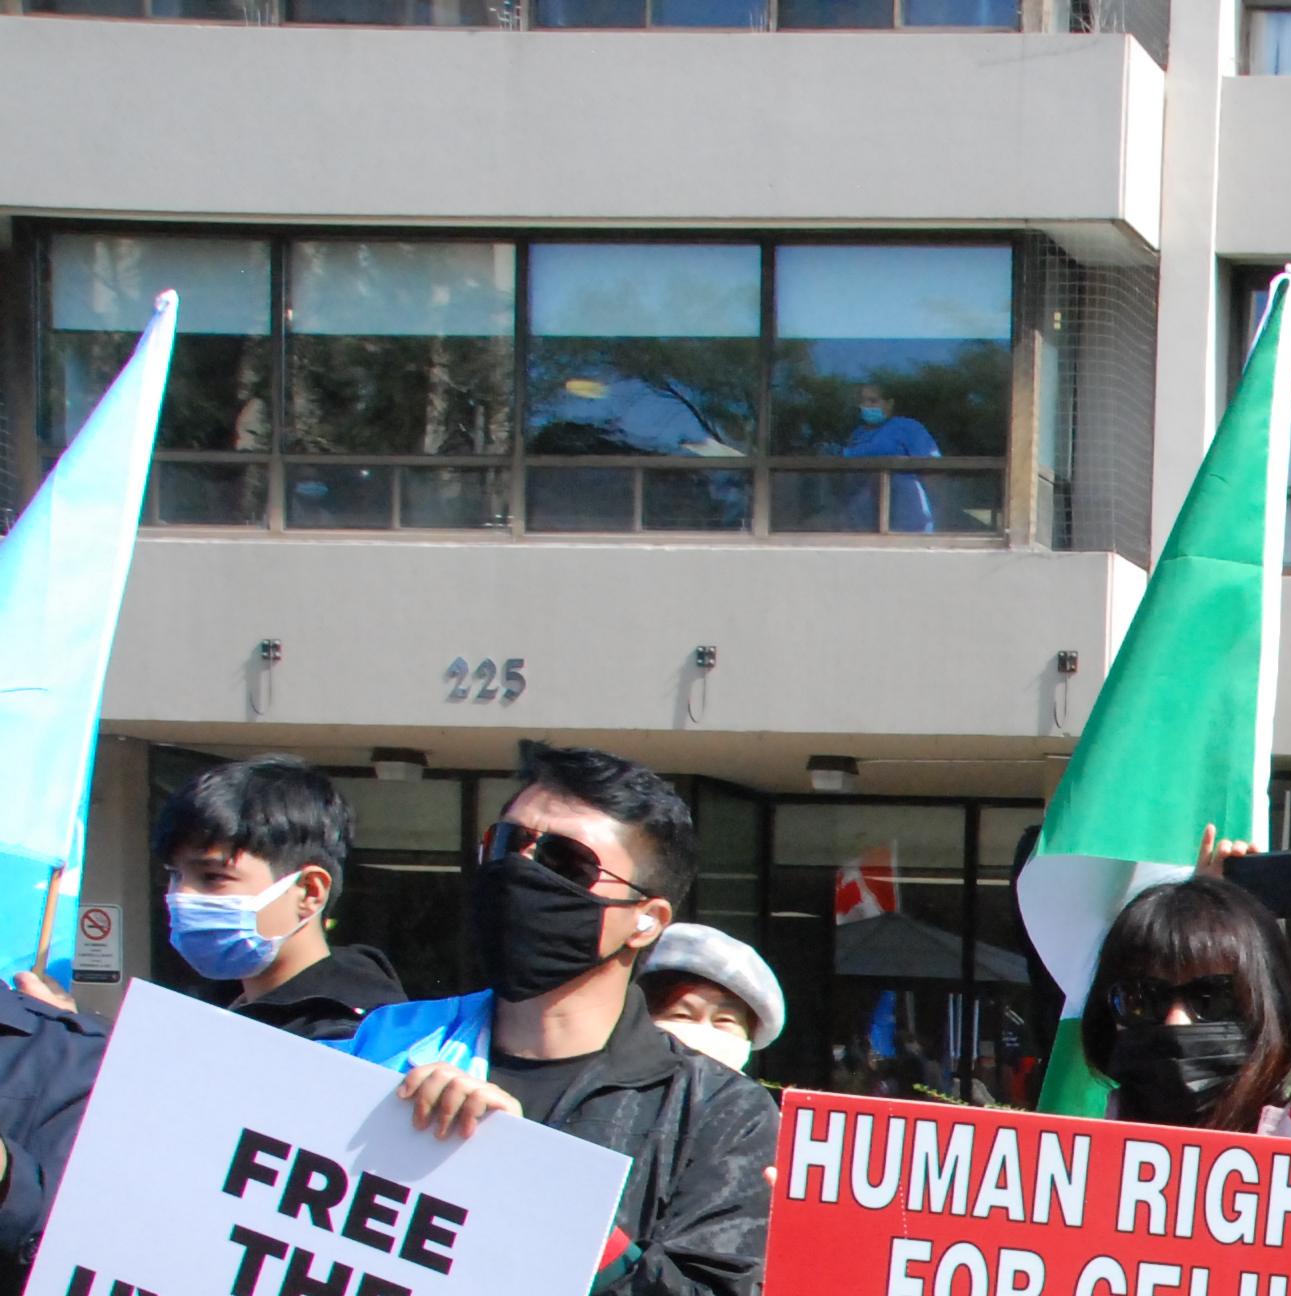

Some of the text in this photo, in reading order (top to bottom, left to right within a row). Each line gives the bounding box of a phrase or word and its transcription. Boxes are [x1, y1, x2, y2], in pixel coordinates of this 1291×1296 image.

[446, 656, 527, 702] 225
[222, 1128, 468, 1275] FREE
[788, 1109, 1091, 1228] HUMAN
